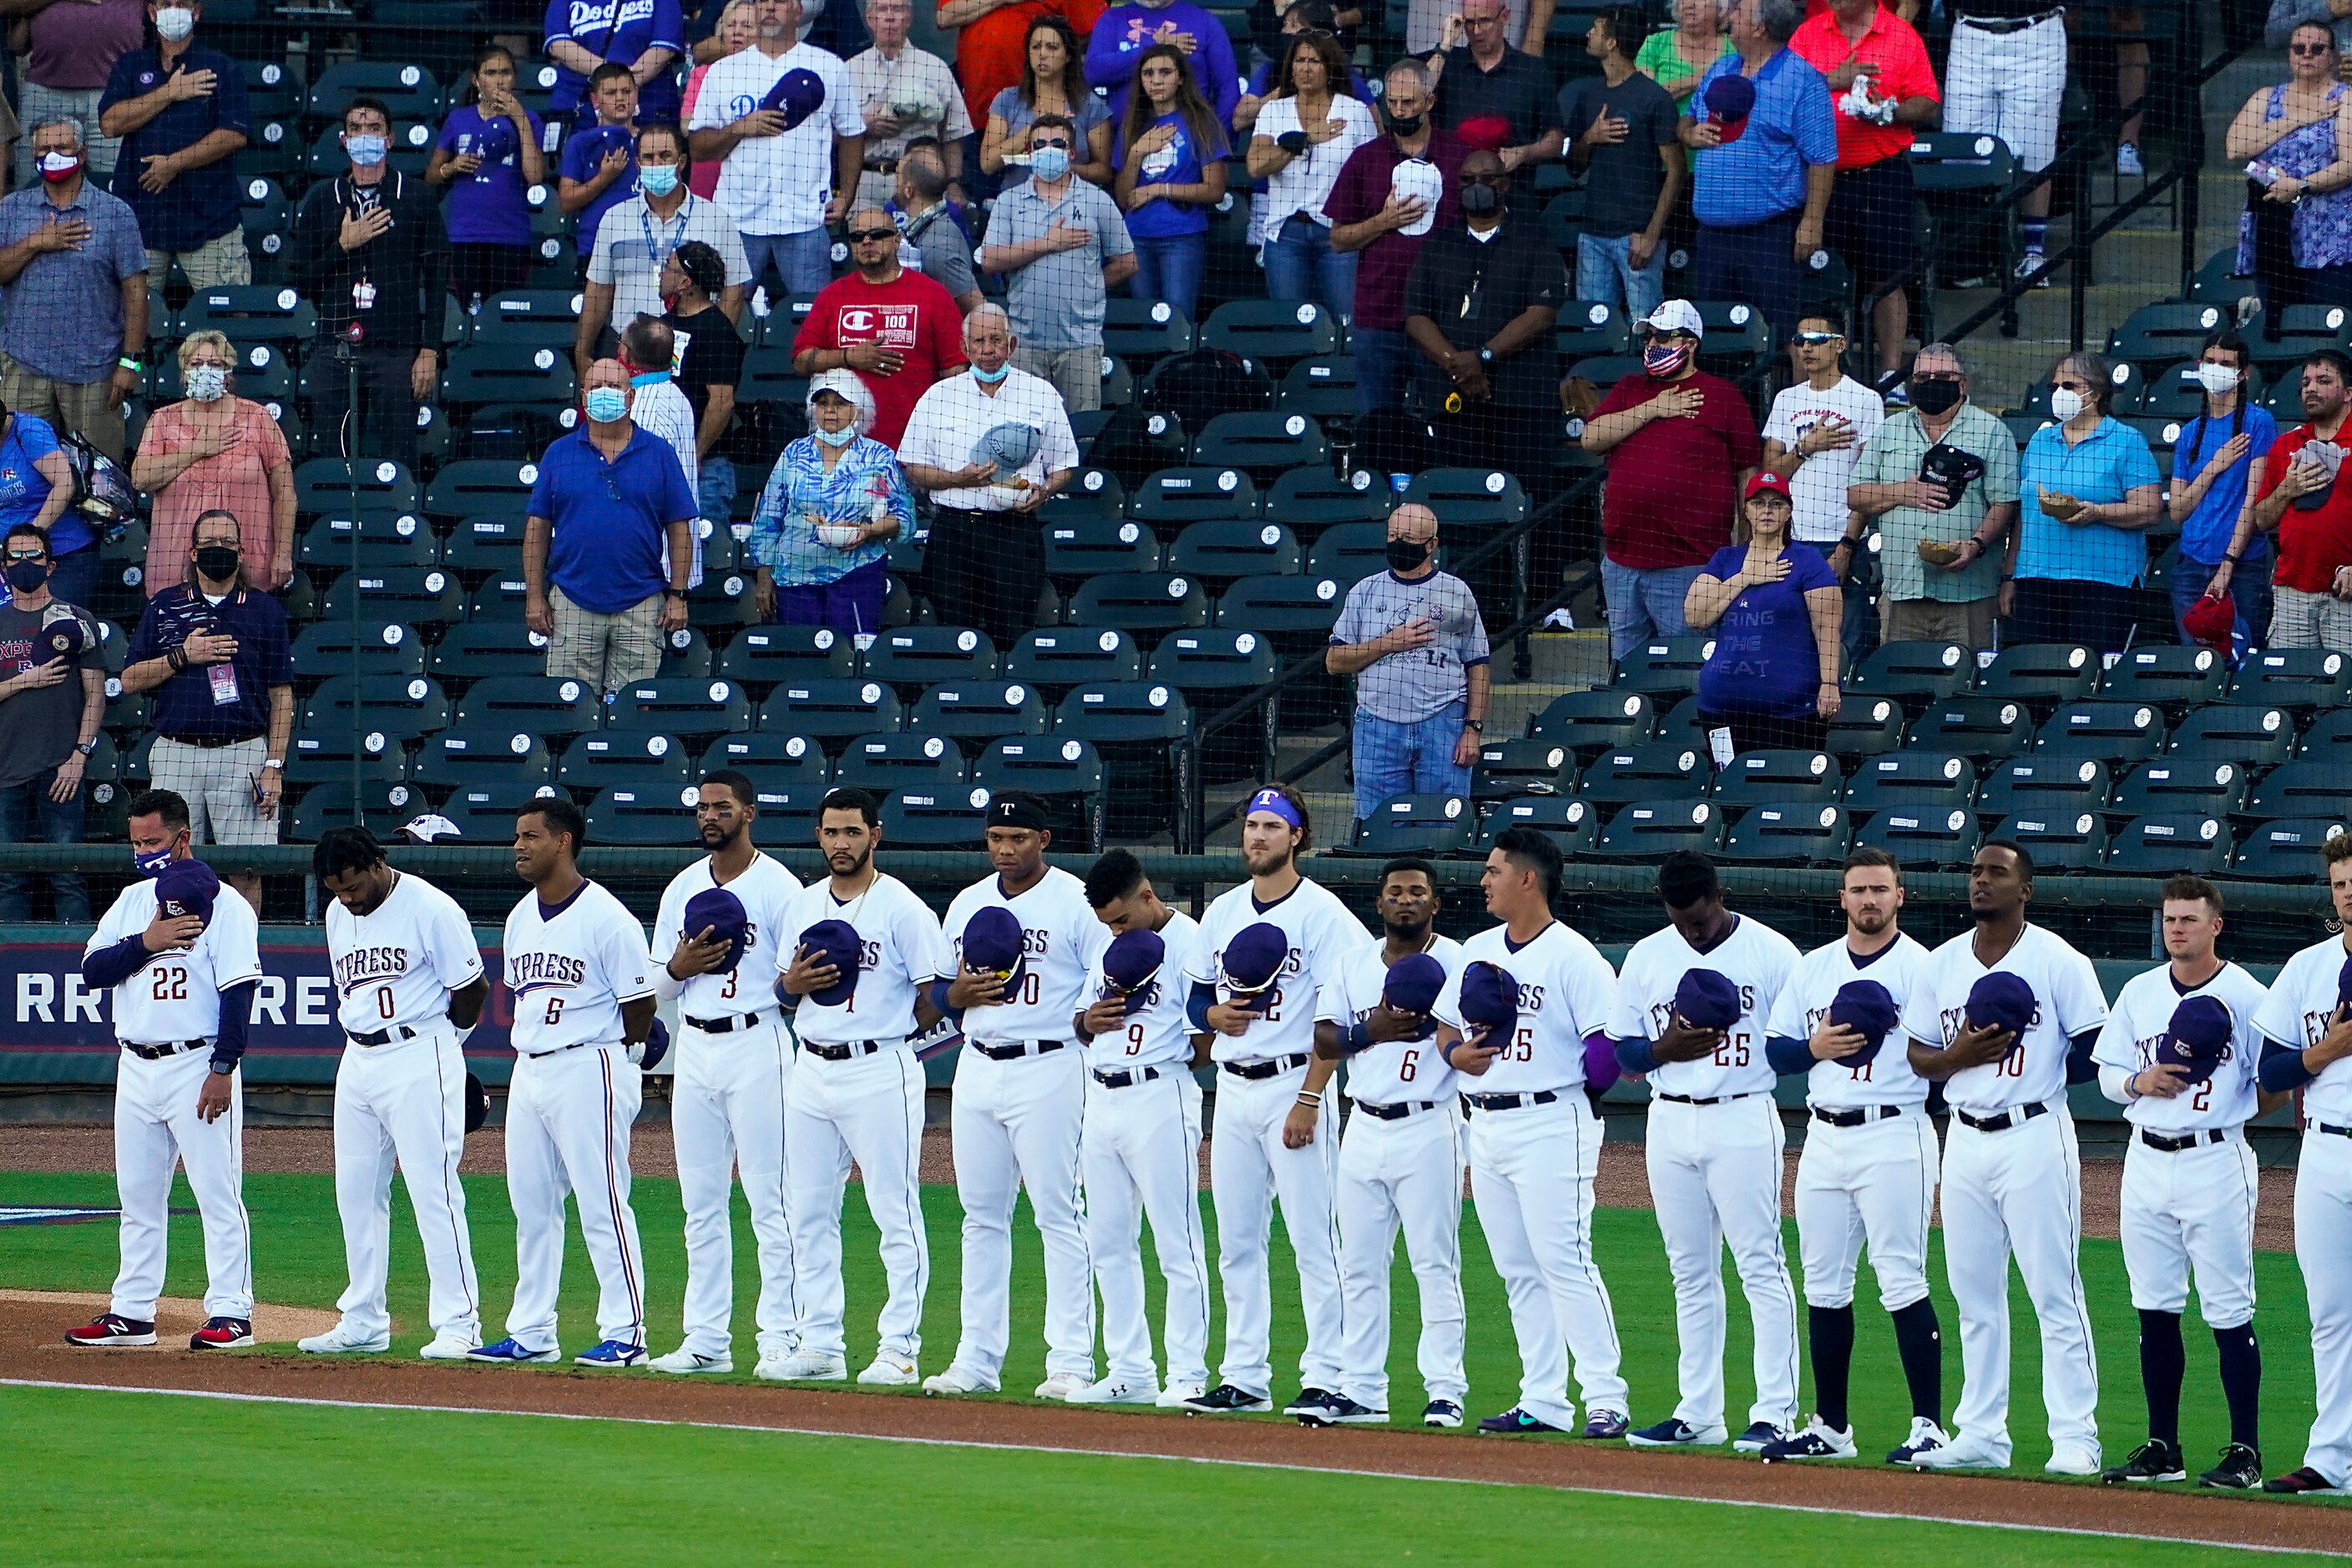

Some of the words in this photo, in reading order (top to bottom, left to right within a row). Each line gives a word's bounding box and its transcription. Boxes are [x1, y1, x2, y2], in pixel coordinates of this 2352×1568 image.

[1676, 255, 1682, 263] 2
[885, 315, 908, 328] 100
[731, 582, 736, 590] 5
[1723, 635, 1762, 651] THE
[213, 680, 234, 689] MEDIA
[1000, 802, 1015, 816] T
[1257, 790, 1280, 806] T
[153, 967, 188, 1000] 22
[721, 969, 738, 999] 3
[1003, 973, 1040, 1005] 0
[377, 986, 395, 1019] 0
[544, 997, 564, 1026] 5
[1255, 989, 1283, 1022] 2
[1125, 1023, 1145, 1055] 9
[1714, 1033, 1751, 1066] 25
[1399, 1050, 1420, 1082] 6
[2192, 1078, 2213, 1112] 2
